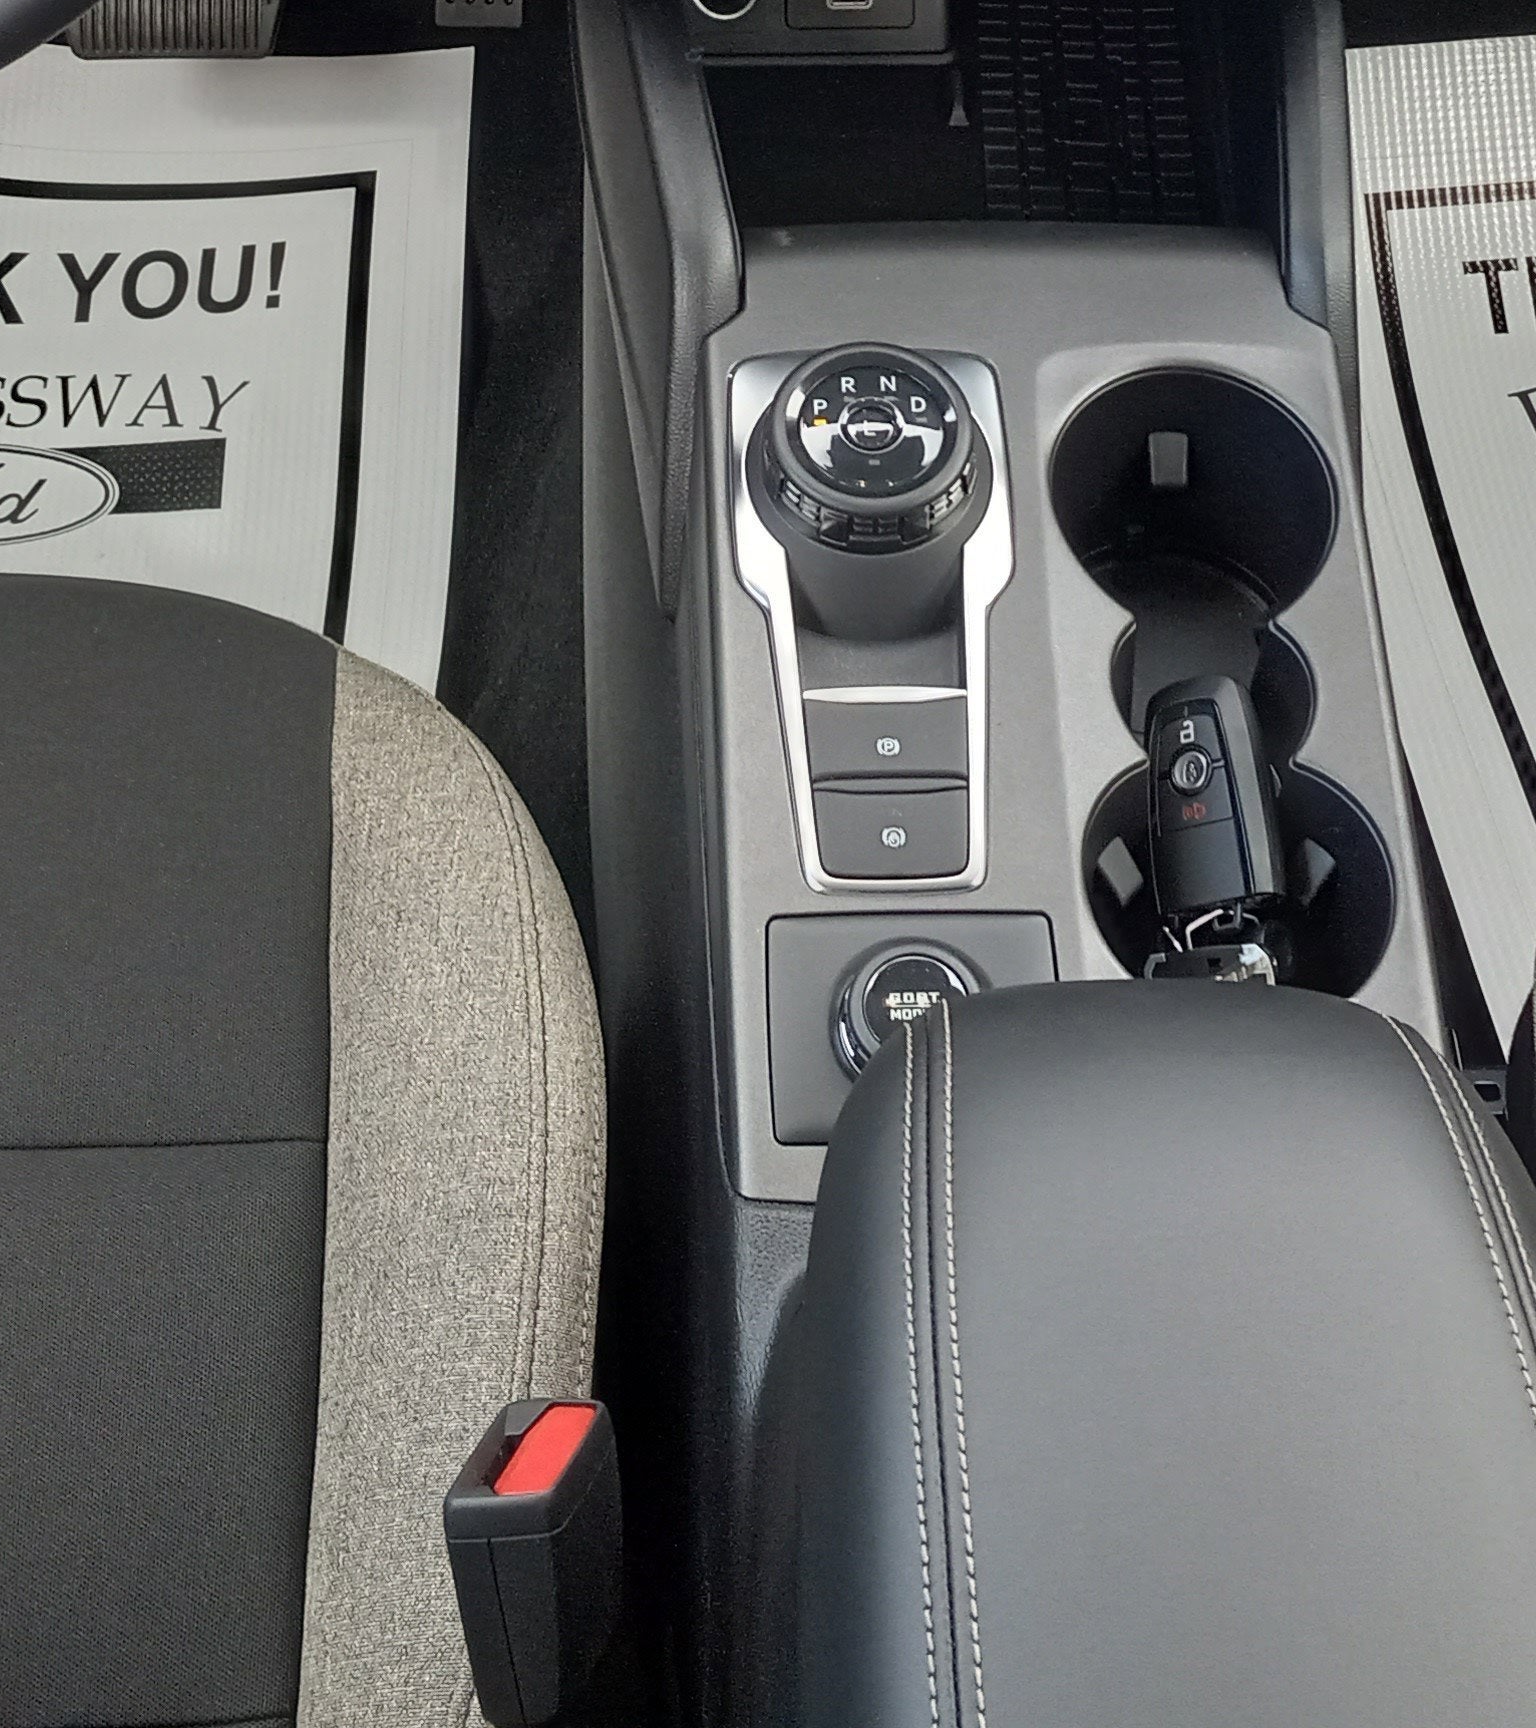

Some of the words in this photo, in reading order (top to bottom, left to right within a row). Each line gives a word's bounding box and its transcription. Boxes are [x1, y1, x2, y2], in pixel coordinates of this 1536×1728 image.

[56, 240, 287, 323] YOU!
[840, 376, 857, 393] R
[879, 375, 897, 392] N
[813, 399, 828, 415] P
[909, 396, 927, 413] D
